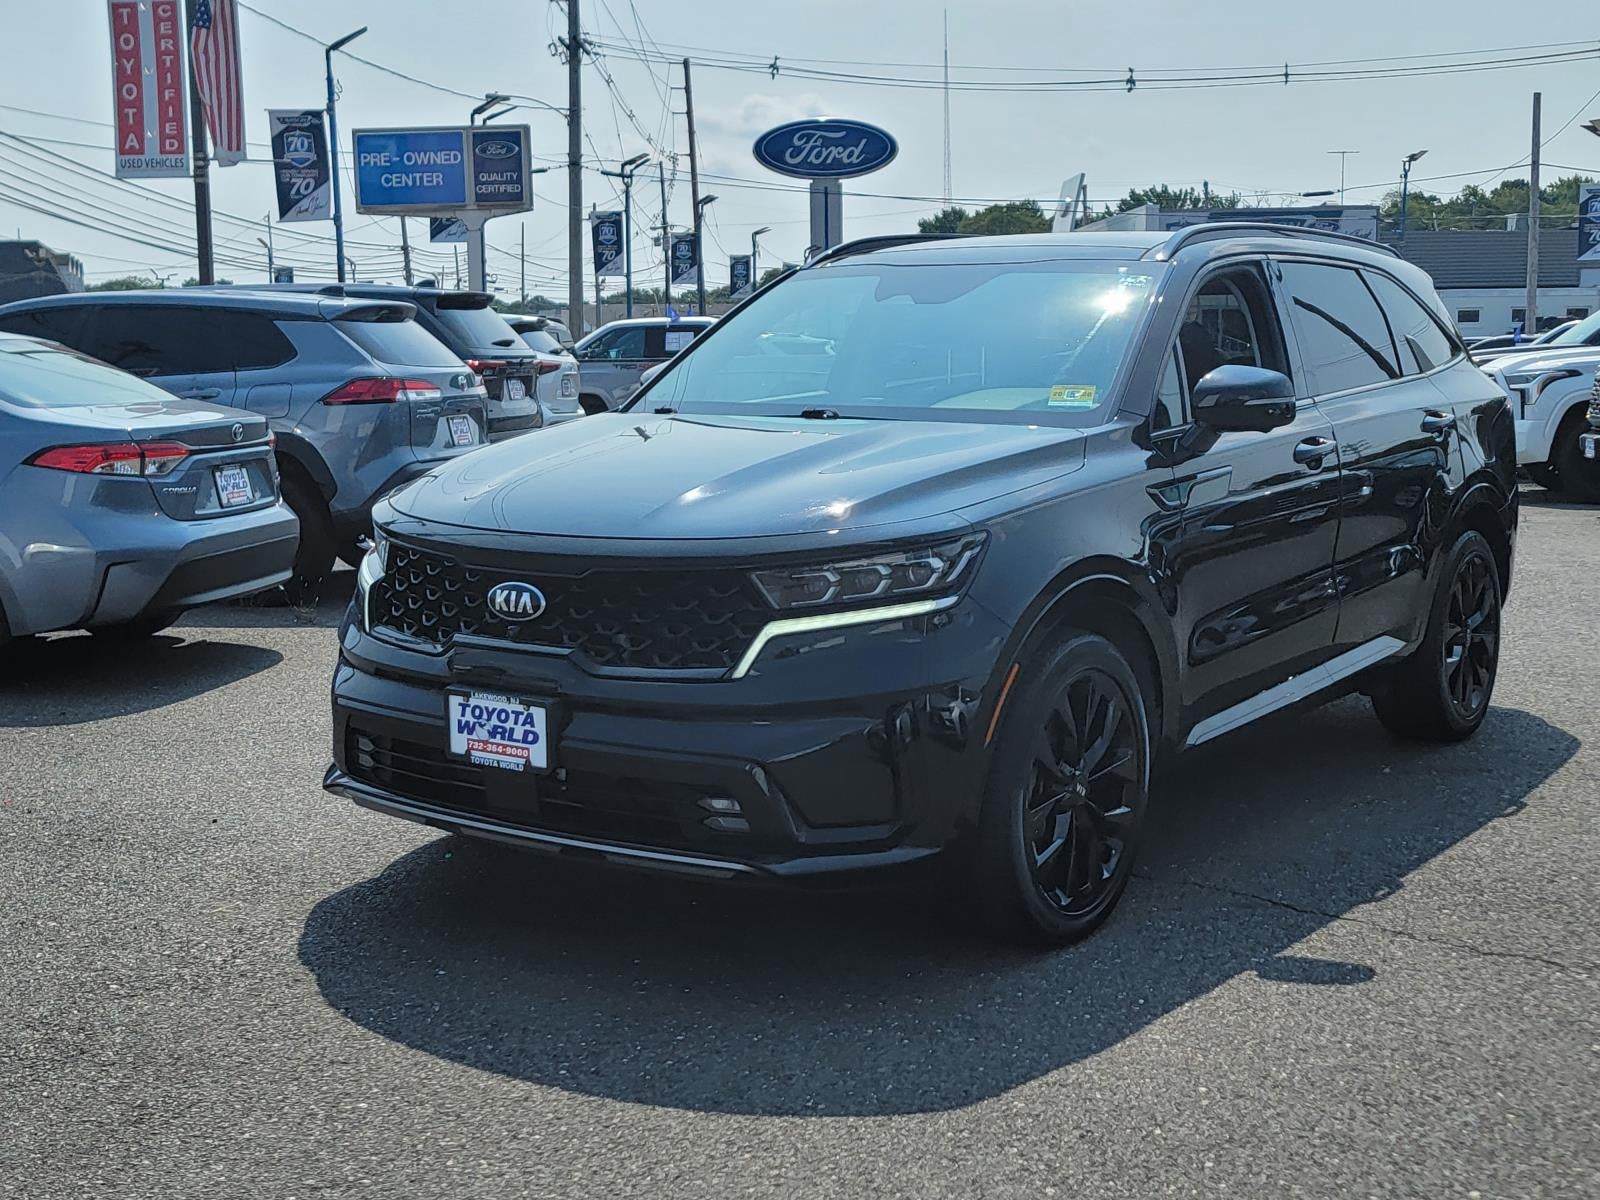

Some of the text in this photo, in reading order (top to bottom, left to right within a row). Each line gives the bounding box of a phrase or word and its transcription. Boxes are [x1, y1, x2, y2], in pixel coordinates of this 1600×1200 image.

[119, 8, 140, 150] TOYOTA
[158, 5, 179, 150] CERTIFIED
[785, 130, 866, 164] Ford
[120, 157, 185, 169] USED VEHICLES
[381, 173, 443, 188] CENTER
[479, 171, 518, 182] QUALITY
[289, 177, 316, 199] 70
[476, 183, 521, 193] CERTIFIED
[602, 250, 616, 262] 70
[494, 589, 534, 614] KIA
[470, 691, 510, 704] LAKEWOOD,
[458, 702, 536, 729] TOYOTA
[468, 740, 529, 758] 732-364-9000
[470, 756, 525, 773] TOYOTA WORLD
